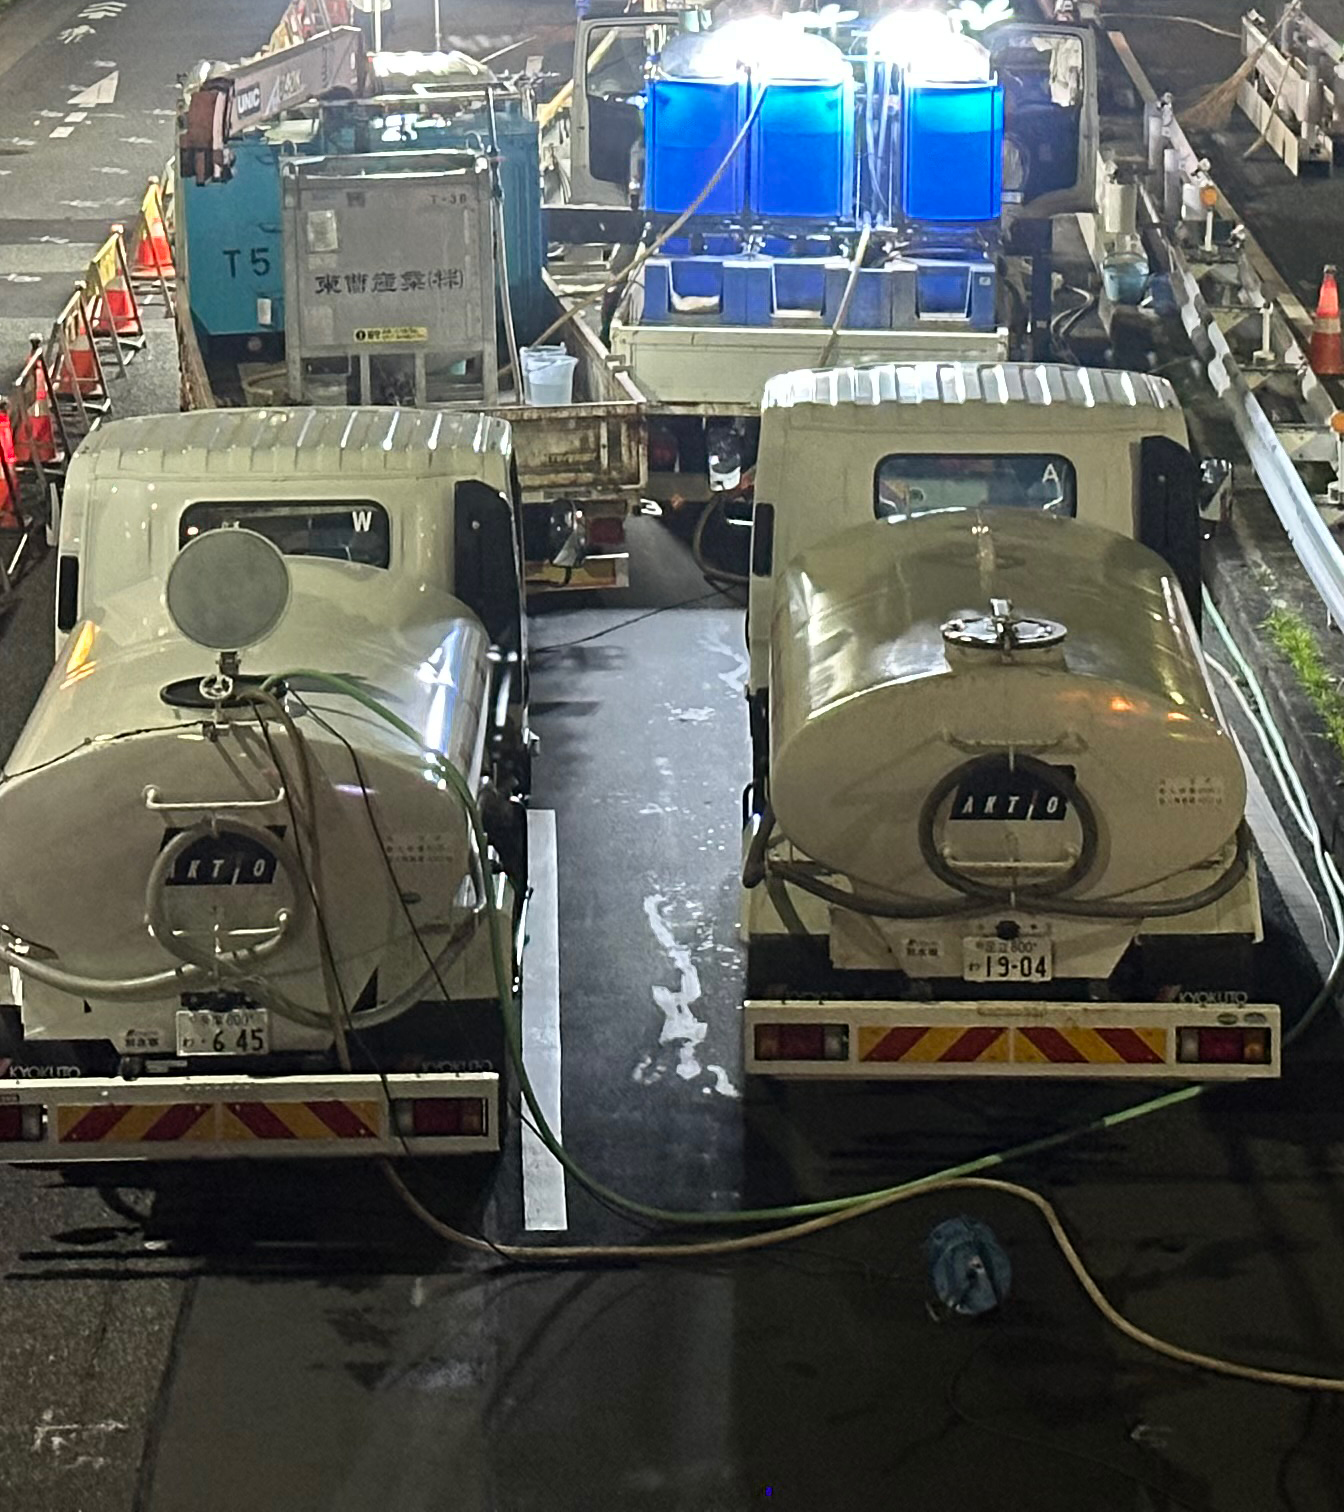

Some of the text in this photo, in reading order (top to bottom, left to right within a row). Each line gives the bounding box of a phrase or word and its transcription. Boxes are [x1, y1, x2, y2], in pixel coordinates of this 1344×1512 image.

[1042, 463, 1059, 483] A
[352, 510, 372, 532] W
[986, 955, 1047, 978] 19-04
[9, 1065, 82, 1078] KYOKUTO
